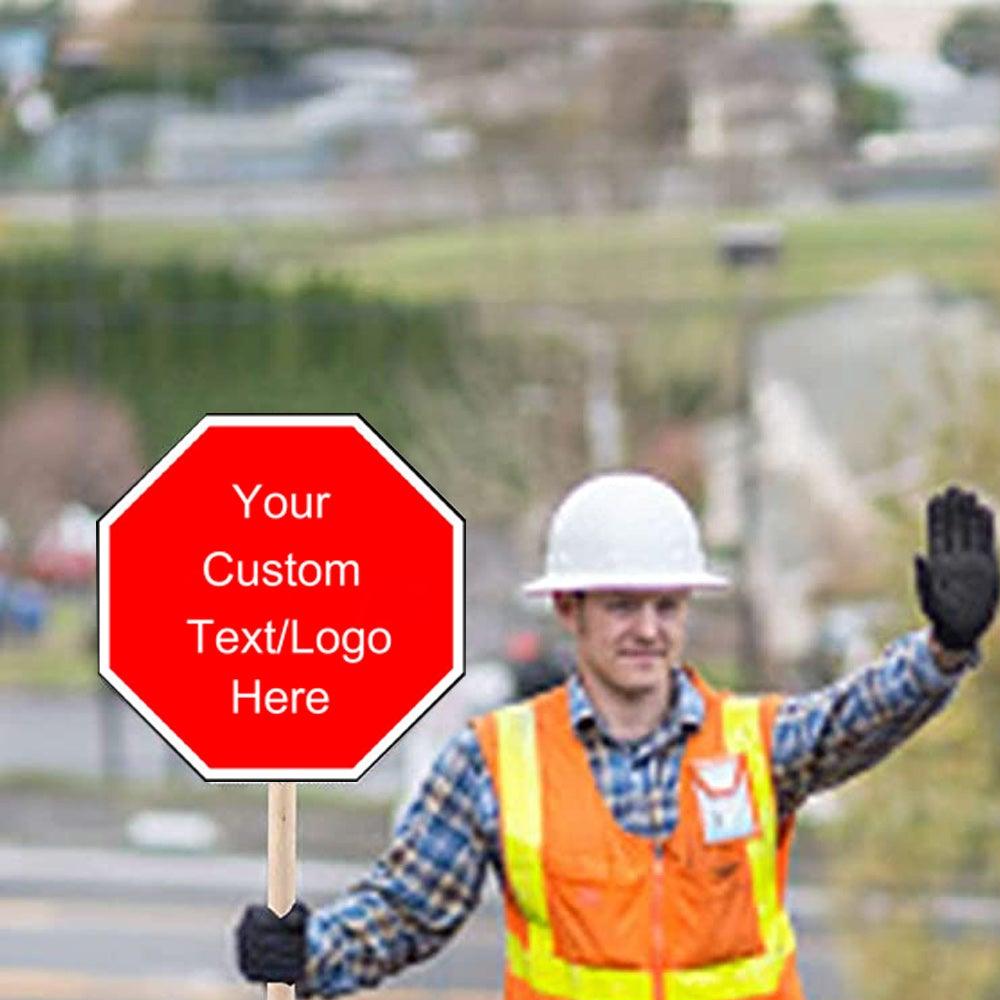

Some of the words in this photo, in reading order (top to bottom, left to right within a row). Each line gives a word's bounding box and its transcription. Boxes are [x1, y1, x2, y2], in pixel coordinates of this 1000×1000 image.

[232, 483, 332, 519] Your
[202, 551, 360, 587] Custom
[186, 618, 392, 664] Text/Logo
[232, 679, 330, 715] Here
